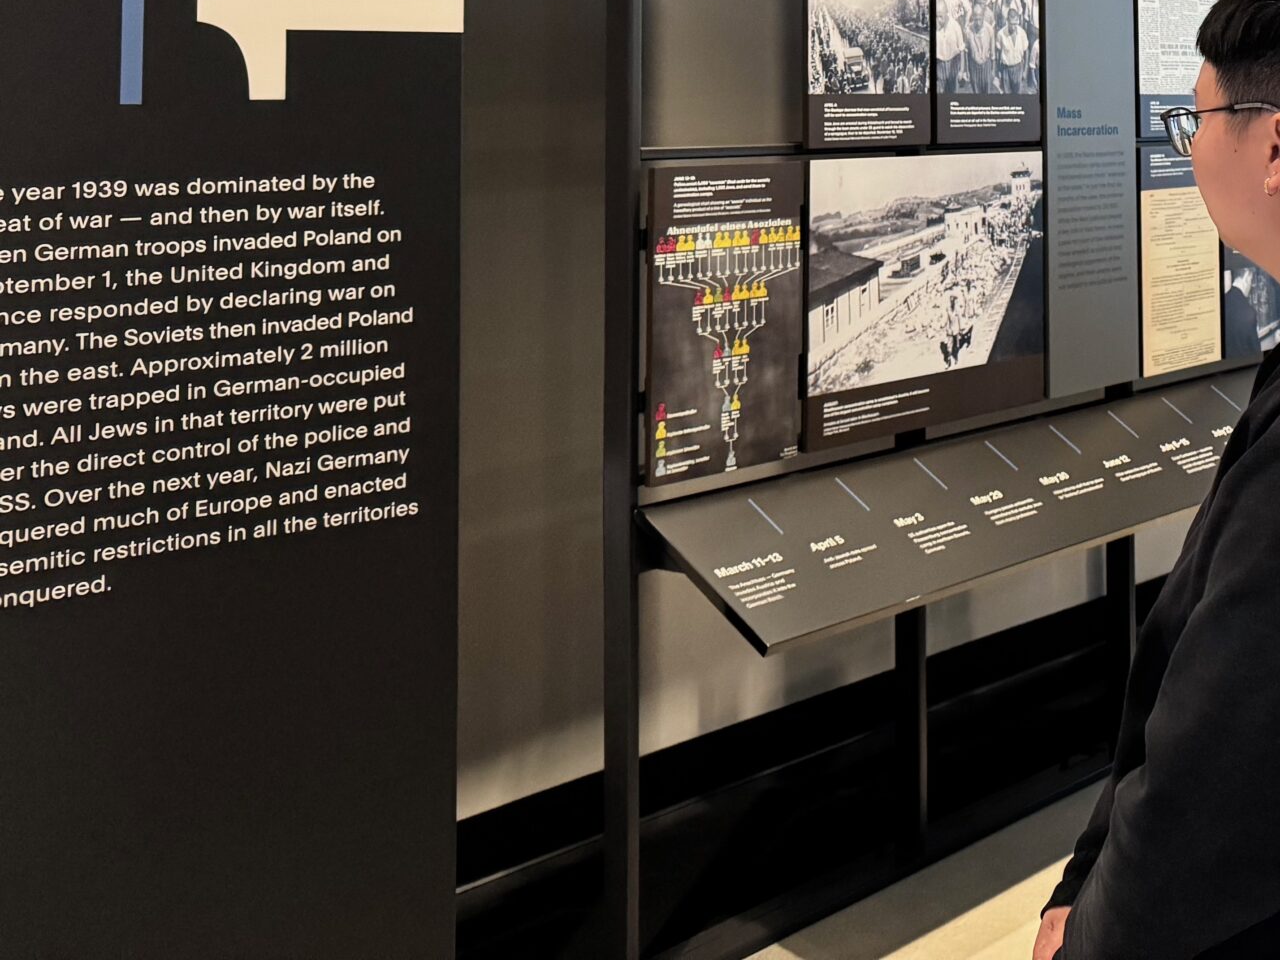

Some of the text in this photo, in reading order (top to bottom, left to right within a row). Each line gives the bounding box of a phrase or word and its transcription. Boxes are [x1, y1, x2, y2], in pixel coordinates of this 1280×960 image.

[1057, 106, 1082, 119] Mass
[1057, 124, 1119, 137] Incarceration
[11, 186, 65, 205] year
[72, 180, 127, 199] 1939
[134, 182, 179, 197] was
[187, 174, 305, 195] dominated
[313, 174, 338, 193] by
[342, 173, 375, 189] the
[39, 212, 63, 231] of
[69, 214, 113, 229] war
[150, 207, 192, 226] and
[199, 206, 249, 223] then
[256, 204, 282, 223] by
[287, 205, 326, 219] war
[331, 199, 384, 217] itself.
[34, 243, 128, 261] German
[135, 239, 207, 257] troops
[213, 231, 297, 252] invaded
[304, 227, 371, 247] Poland
[377, 229, 401, 243] on
[0, 254, 389, 294] tember 1, the United Kingdom and
[50, 296, 178, 323] responded
[187, 295, 214, 314] by
[220, 288, 322, 309] declaring
[328, 286, 365, 301] war
[370, 284, 395, 298] on
[75, 332, 118, 350] The
[124, 325, 204, 346] Soviets
[209, 322, 256, 339] then
[262, 312, 342, 335] invaded
[348, 307, 413, 328] Poland
[19, 367, 59, 386] the
[67, 361, 123, 381] east.
[130, 346, 295, 378] Approximately
[301, 343, 313, 360] 2
[320, 339, 388, 358] million
[23, 398, 82, 417] were
[89, 384, 180, 411] trapped
[188, 383, 206, 400] in
[213, 362, 405, 397] German-occupied
[50, 424, 81, 445] All
[88, 421, 148, 440] Jews
[155, 416, 174, 433] in
[181, 410, 224, 430] that
[229, 403, 313, 425] territory
[318, 397, 368, 415] were
[374, 391, 406, 412] put
[30, 459, 70, 478] the
[77, 449, 145, 472] direct
[152, 438, 230, 463] control
[238, 434, 259, 453] of
[264, 432, 298, 450] the
[305, 425, 368, 448] police
[374, 417, 410, 436] and
[44, 487, 102, 507] Over
[108, 481, 145, 499] the
[153, 472, 201, 493] next
[207, 468, 258, 490] year,
[266, 457, 310, 478] Nazi
[317, 448, 410, 471] Germany
[94, 507, 159, 532] much
[166, 502, 189, 521] of
[196, 495, 272, 517] Europe
[279, 484, 318, 505] and
[324, 472, 406, 499] enacted
[94, 531, 221, 562] restrictions
[228, 525, 246, 542] in
[253, 519, 277, 538] all
[283, 516, 317, 534] the
[323, 502, 418, 528] territories
[810, 539, 836, 553] April
[714, 561, 753, 579] March
[0, 574, 111, 608] nquered.
